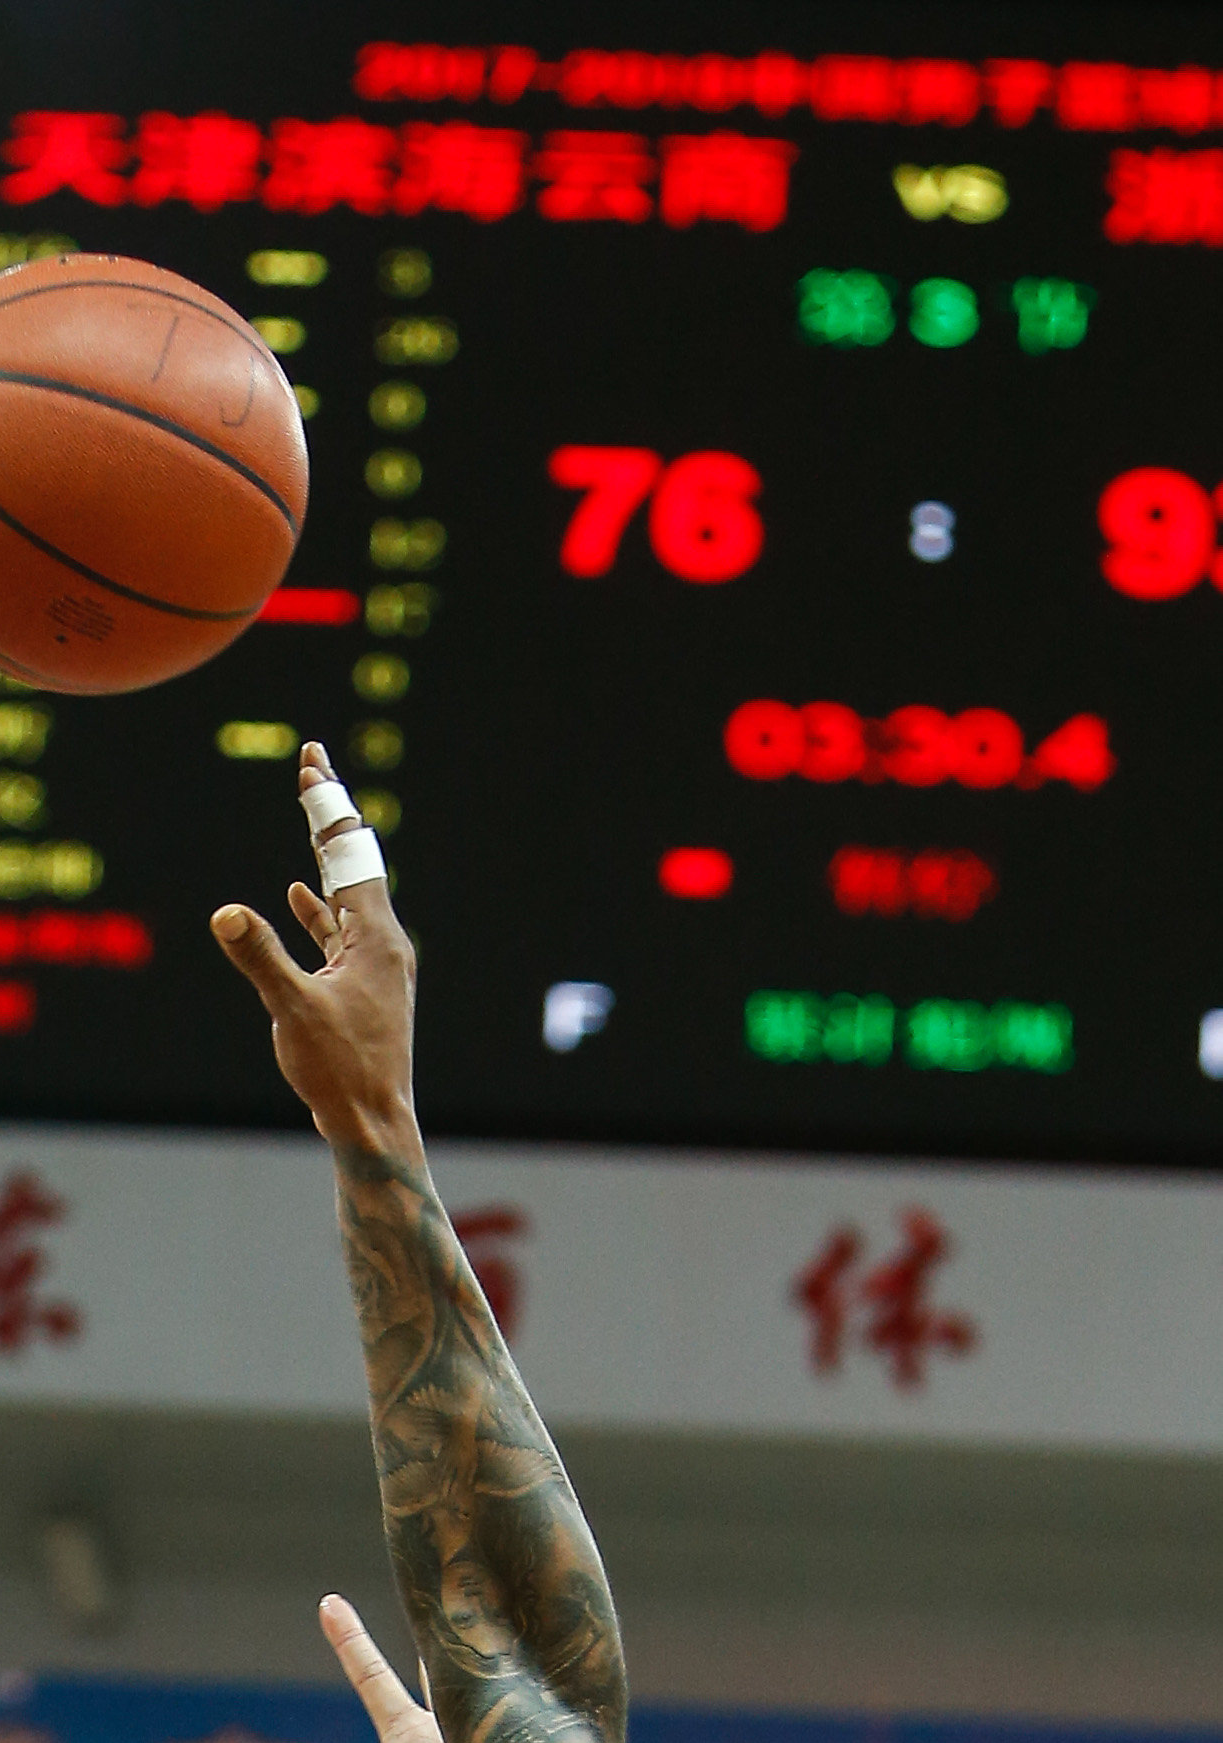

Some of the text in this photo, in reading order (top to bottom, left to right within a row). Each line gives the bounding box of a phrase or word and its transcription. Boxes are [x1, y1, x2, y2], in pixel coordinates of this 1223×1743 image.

[355, 42, 1223, 131] 2017-2018中国男子篮球
[549, 445, 764, 584] 76
[1098, 466, 1223, 600] 9
[724, 699, 1115, 790] 03:30.4
